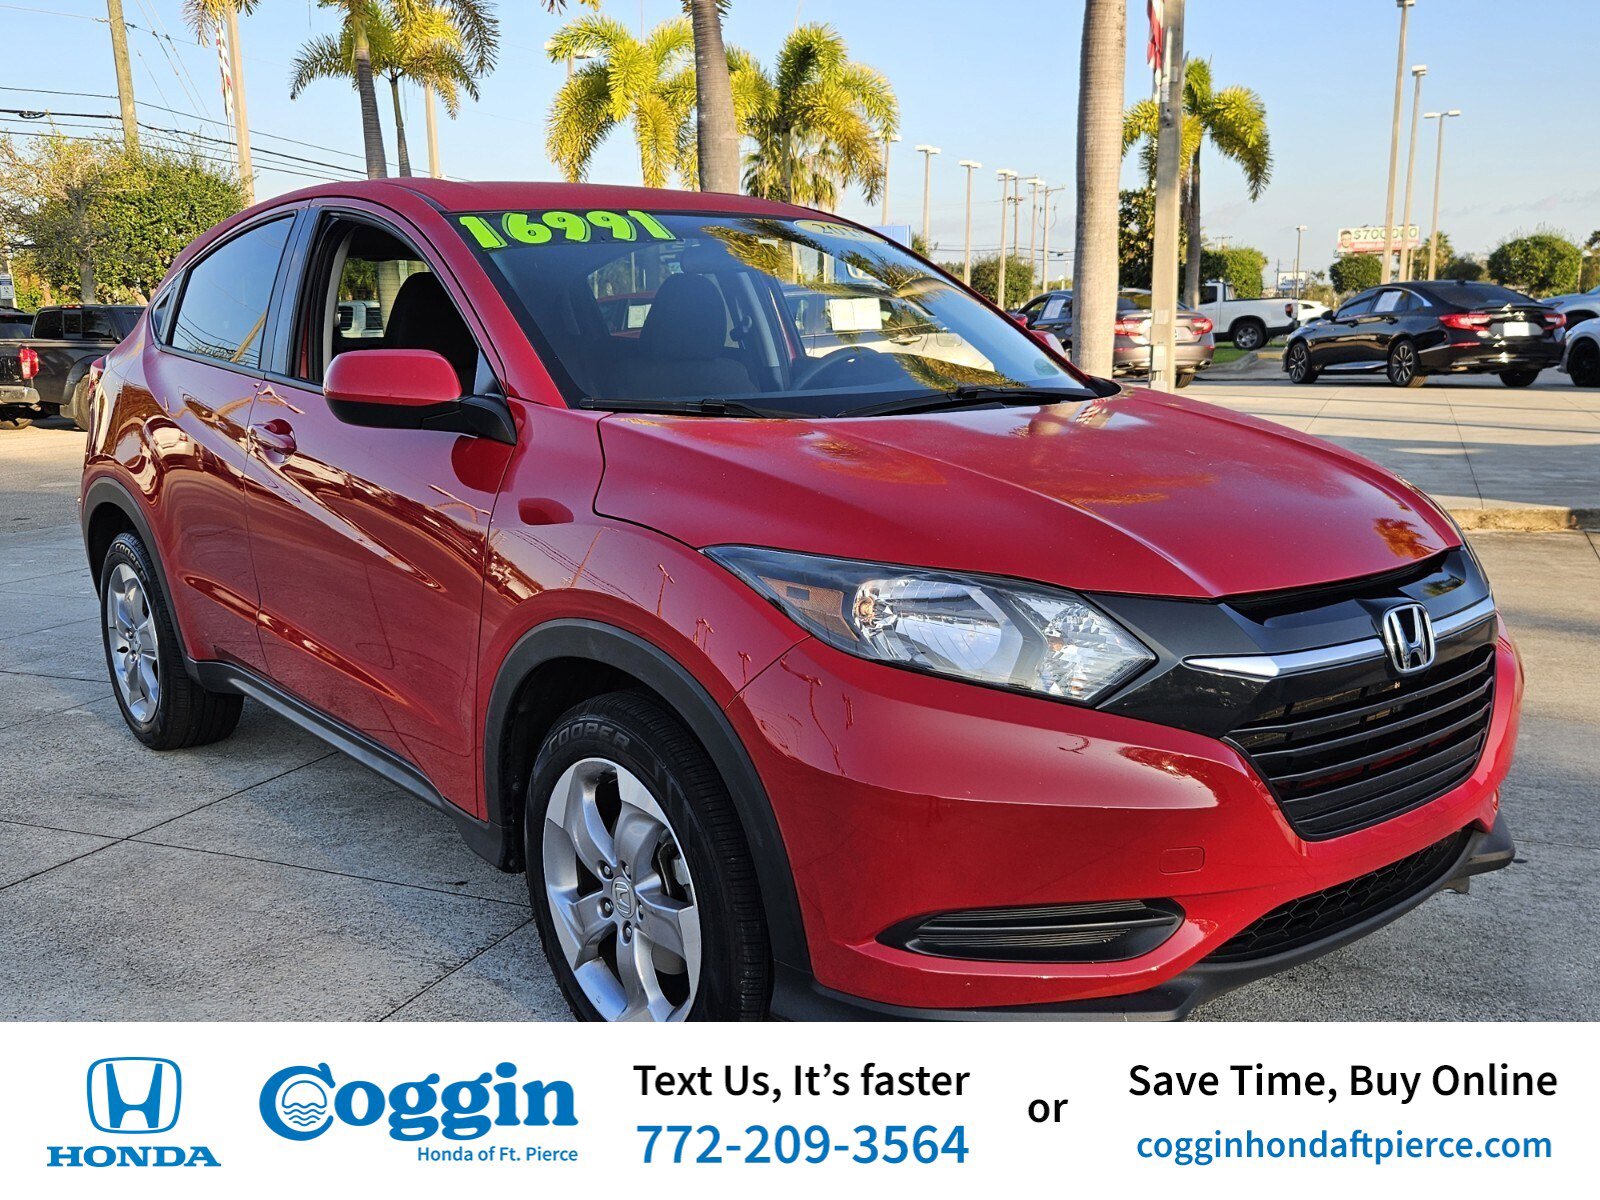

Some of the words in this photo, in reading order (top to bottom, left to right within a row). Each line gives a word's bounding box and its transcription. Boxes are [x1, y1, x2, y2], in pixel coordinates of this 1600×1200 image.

[459, 210, 677, 249] 16991
[1354, 228, 1418, 240] $70000
[549, 722, 630, 754] COOPER
